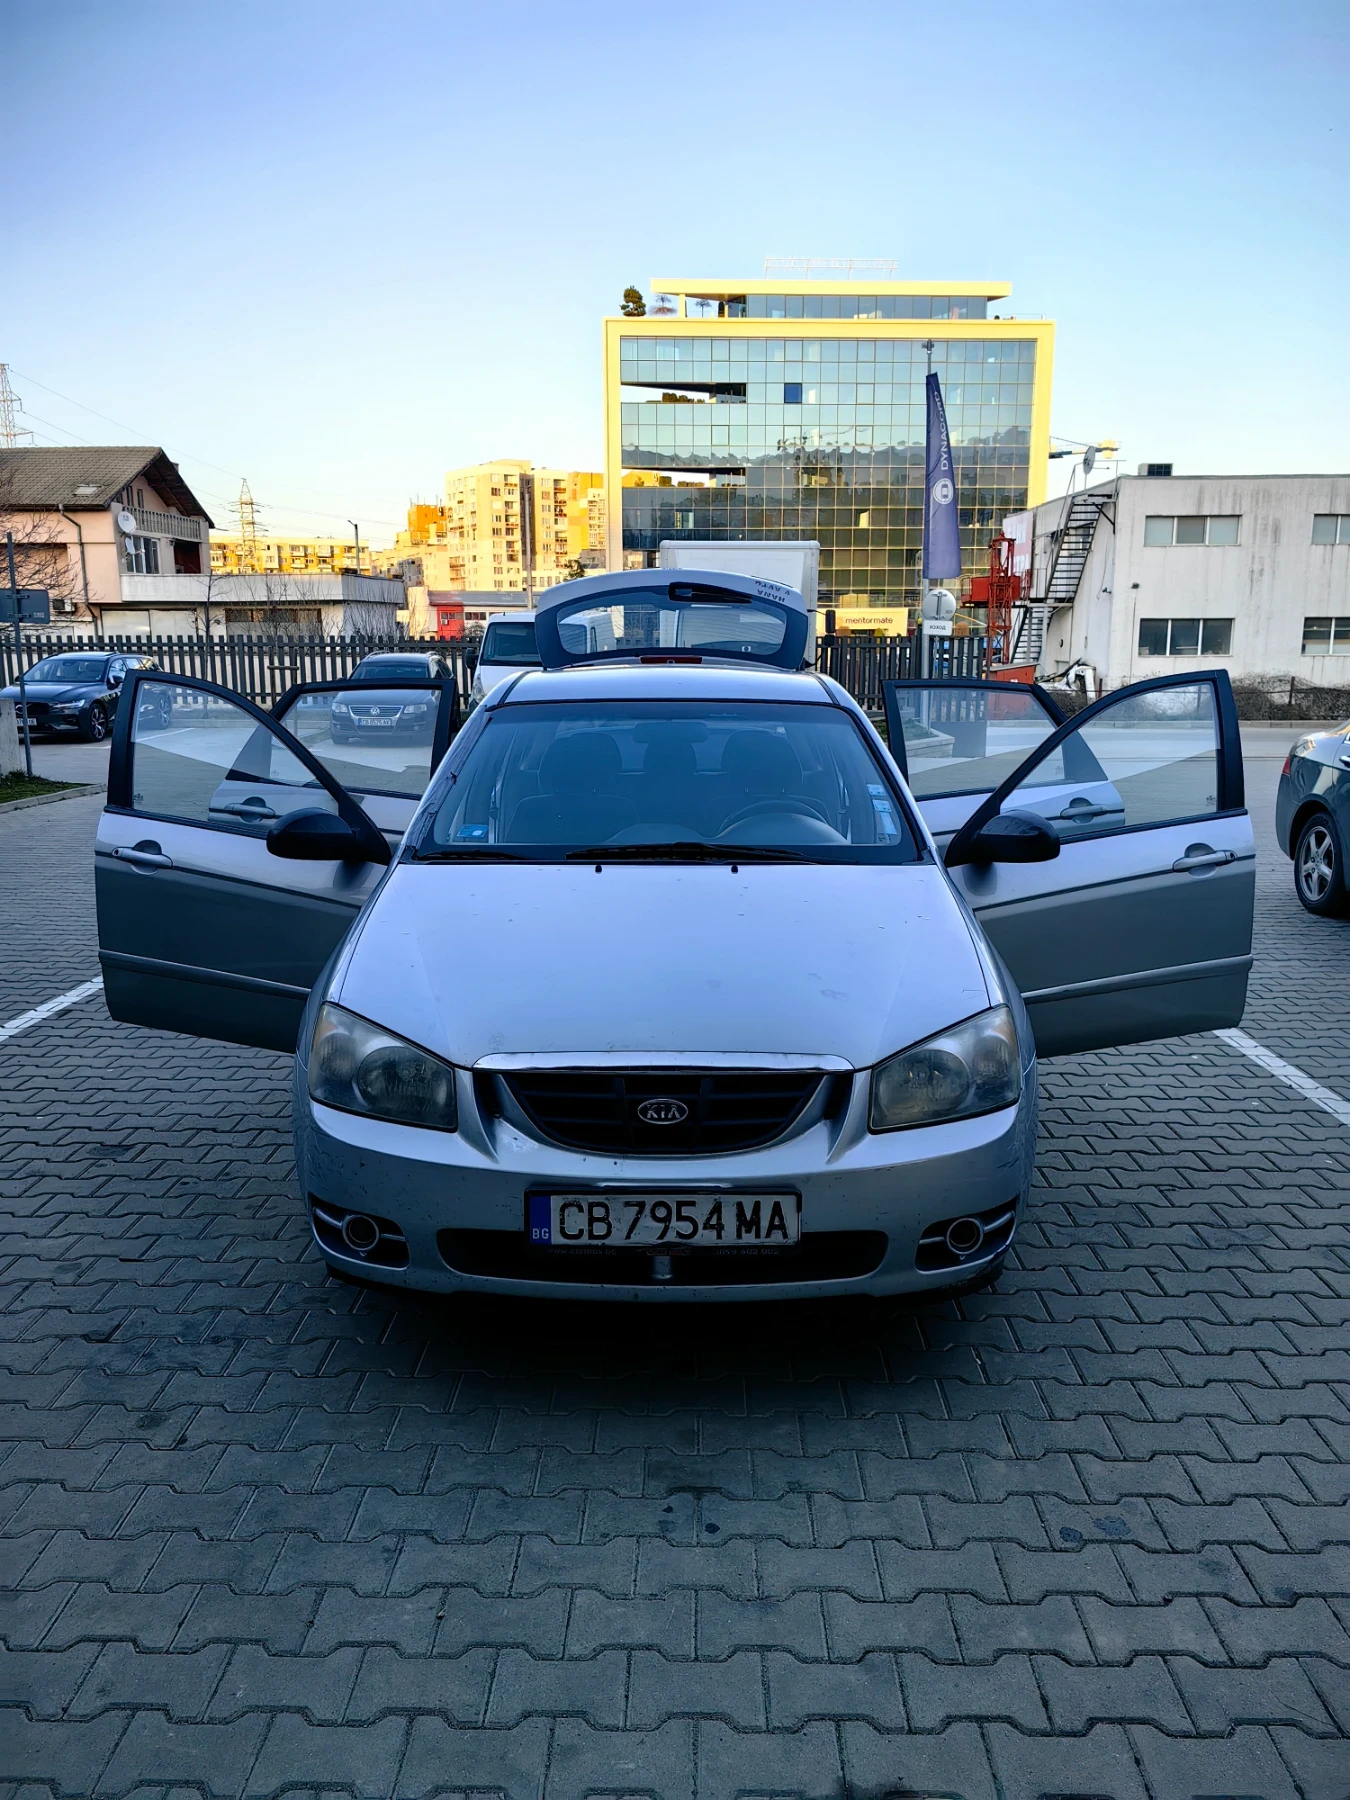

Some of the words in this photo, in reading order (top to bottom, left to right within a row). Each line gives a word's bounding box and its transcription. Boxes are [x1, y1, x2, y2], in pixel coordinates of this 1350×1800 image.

[934, 391, 949, 470] DYNACORD
[647, 1105, 681, 1118] KIA
[559, 1201, 613, 1240] CB
[623, 1200, 725, 1240] 7954
[735, 1200, 789, 1240] MA
[532, 1228, 549, 1239] BG
